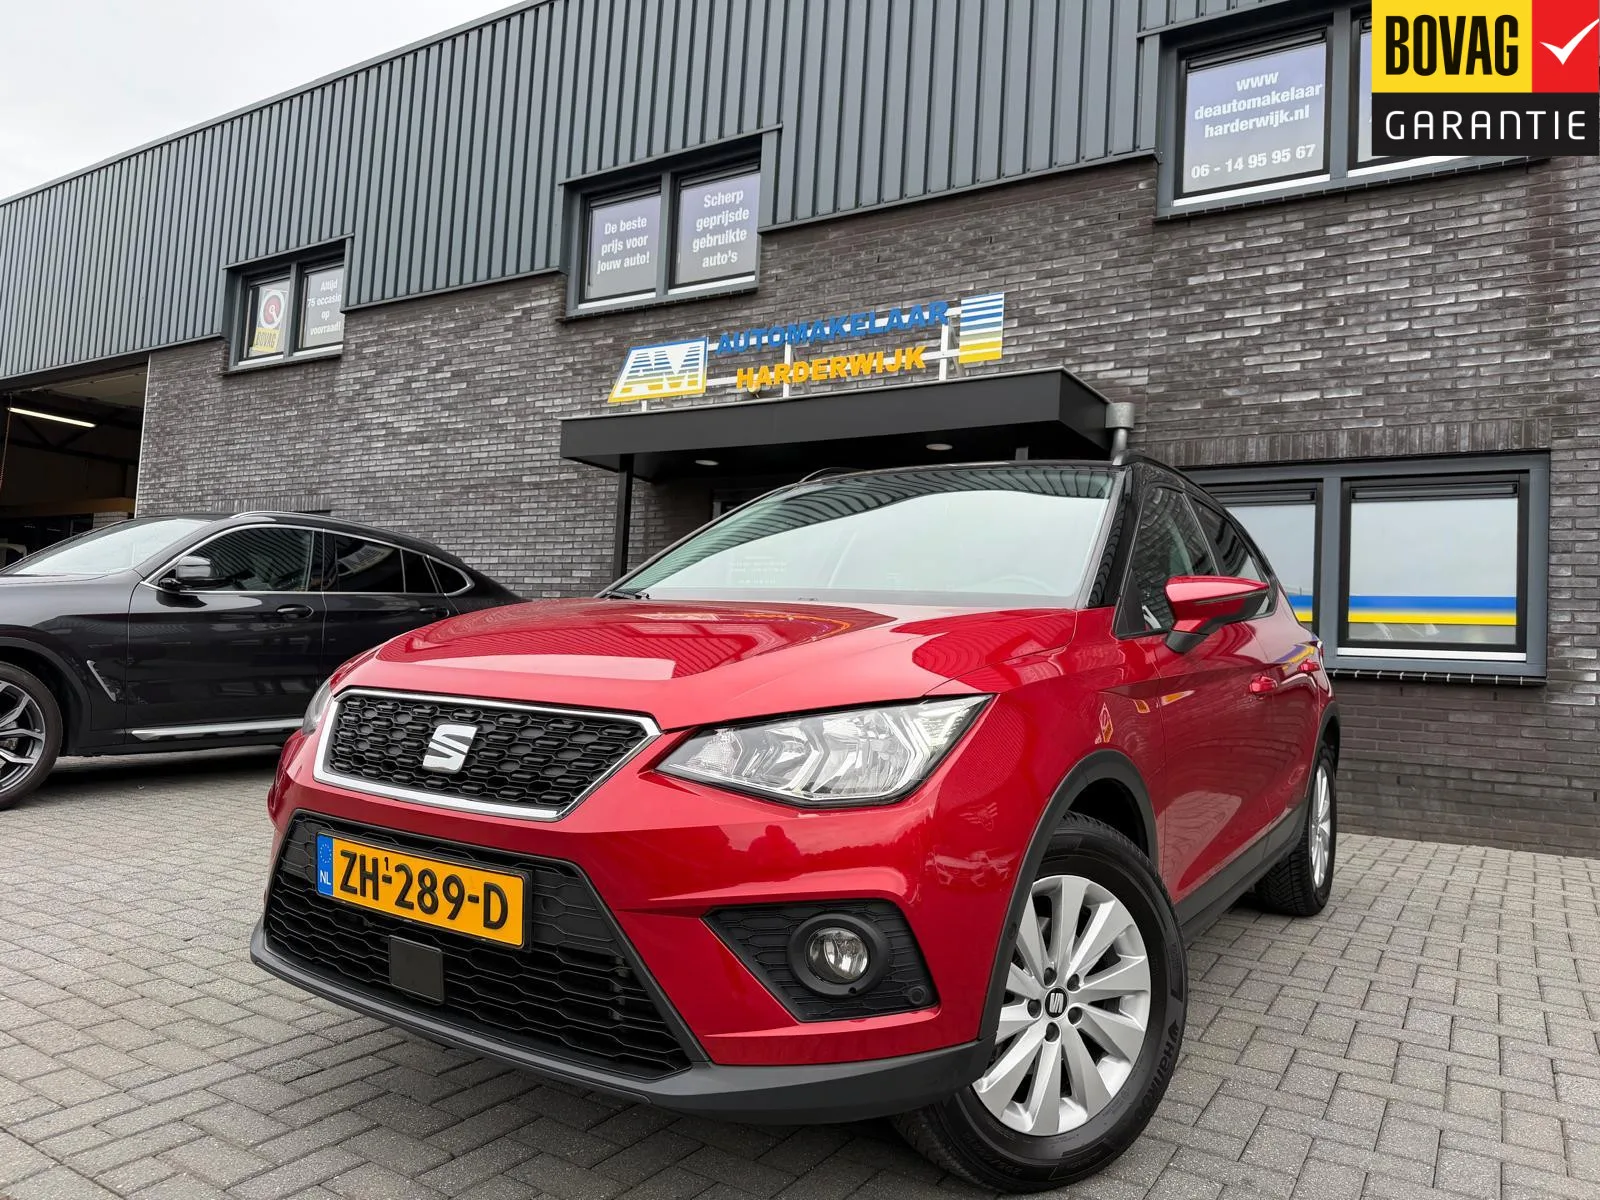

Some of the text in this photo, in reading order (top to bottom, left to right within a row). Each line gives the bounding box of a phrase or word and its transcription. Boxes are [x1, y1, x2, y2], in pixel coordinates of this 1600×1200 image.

[1236, 72, 1279, 92] www
[1194, 83, 1323, 120] deautomakelaar
[1204, 104, 1310, 138] harderwijk.nl
[1190, 164, 1210, 179] 06
[1225, 158, 1244, 173] 14
[1247, 152, 1267, 168] 95
[1272, 148, 1291, 164] 95
[1296, 144, 1316, 159] 67
[703, 189, 744, 208] Scherp
[604, 216, 647, 235] De beste
[696, 208, 750, 231] geprijsde
[601, 235, 648, 256] prijs voor
[692, 228, 748, 252] gebruikte
[597, 252, 650, 274] jouw auto!
[702, 250, 738, 268] auto's
[321, 310, 330, 320] op
[714, 301, 949, 355] AUTOMAKELAAR
[620, 344, 703, 393] AM
[736, 345, 927, 390] HARDERWIJK
[319, 869, 332, 886] NL
[339, 849, 509, 930] ZH-289-D
